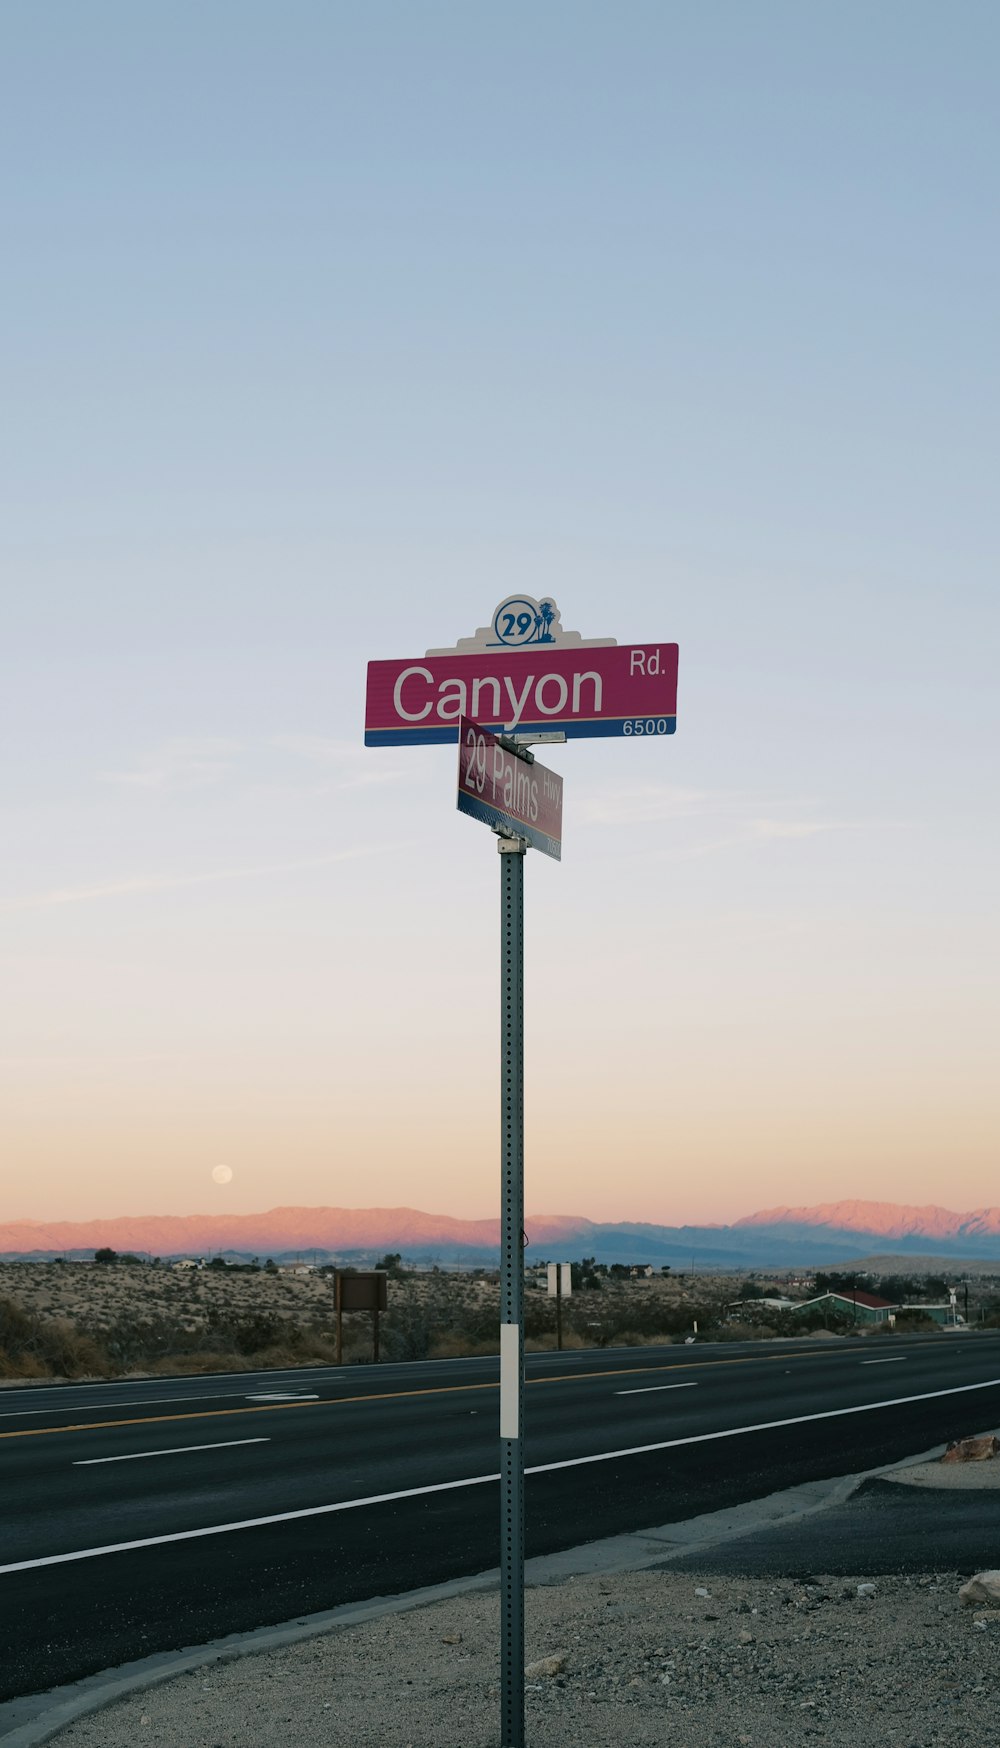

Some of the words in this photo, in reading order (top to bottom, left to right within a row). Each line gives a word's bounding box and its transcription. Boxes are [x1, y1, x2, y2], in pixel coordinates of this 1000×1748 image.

[502, 612, 532, 637] 29
[393, 666, 603, 732] Canyon
[630, 648, 666, 676] Rd.
[622, 718, 667, 736] 6500
[464, 728, 486, 794] 29
[492, 742, 539, 822] Palms
